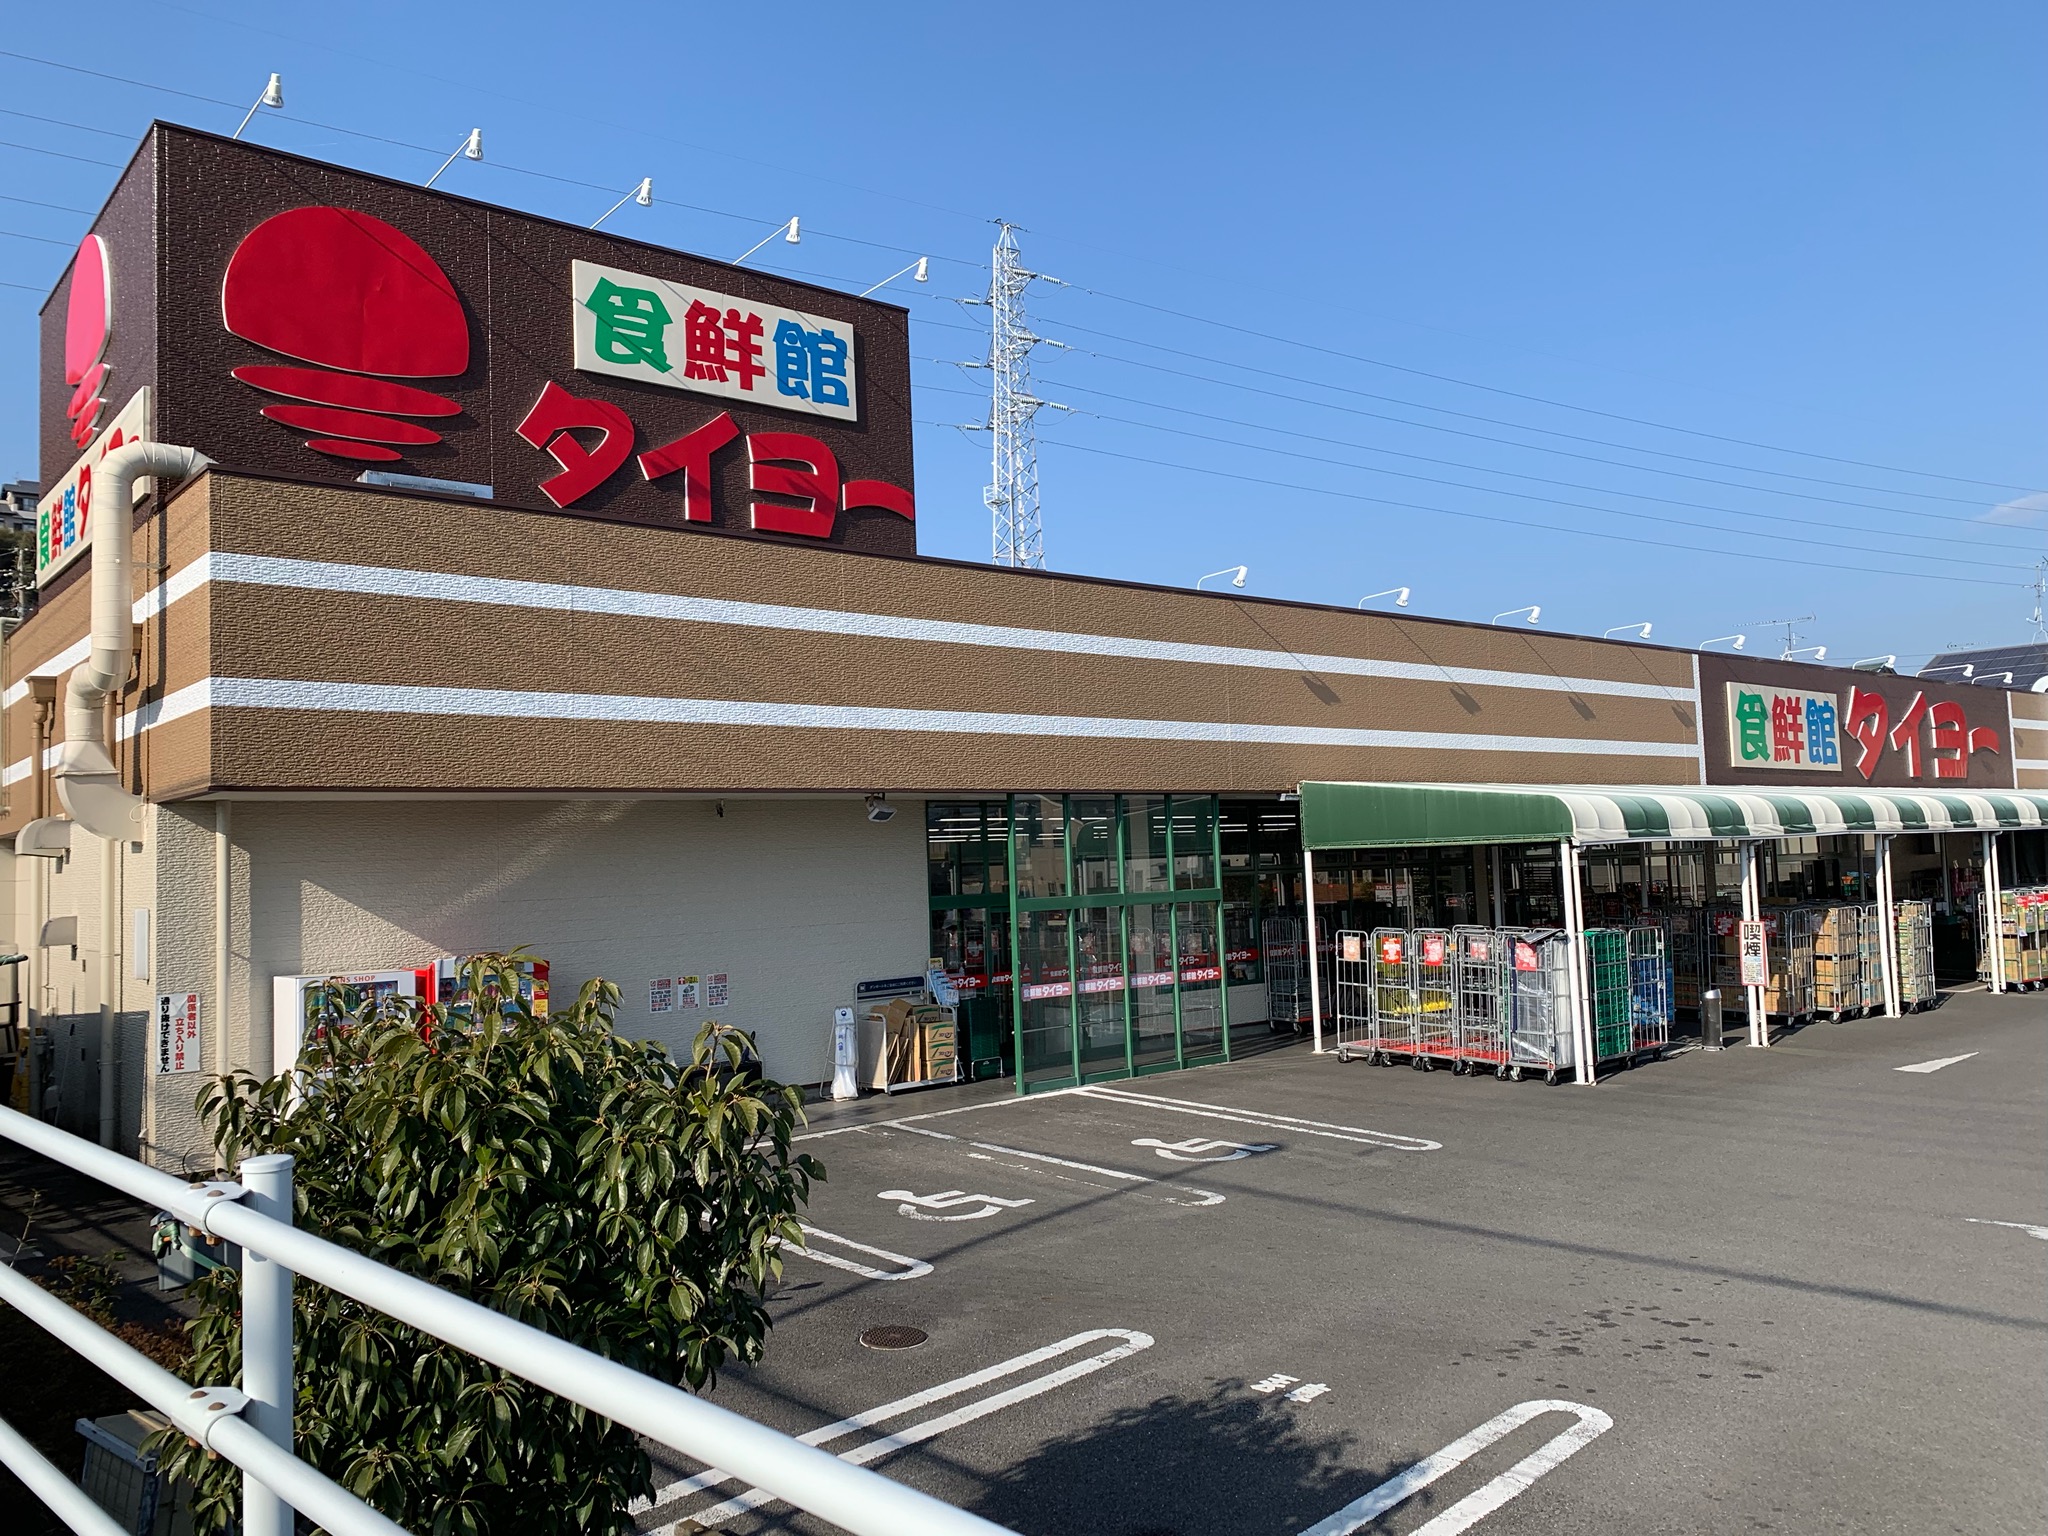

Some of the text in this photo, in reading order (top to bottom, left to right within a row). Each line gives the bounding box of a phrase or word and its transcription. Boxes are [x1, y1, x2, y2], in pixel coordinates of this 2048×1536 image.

[584, 276, 850, 407] 食鮮館
[515, 380, 914, 539] タイヨー
[1735, 690, 1838, 765] 食鮮館
[1844, 685, 2000, 780] タイヨー
[1743, 924, 1761, 957] 喫煙
[186, 994, 197, 1039] 関係者以外
[353, 975, 376, 983] SHOP
[160, 996, 170, 1073] 通り抜けできません
[174, 1018, 185, 1070] 立ち入り禁止
